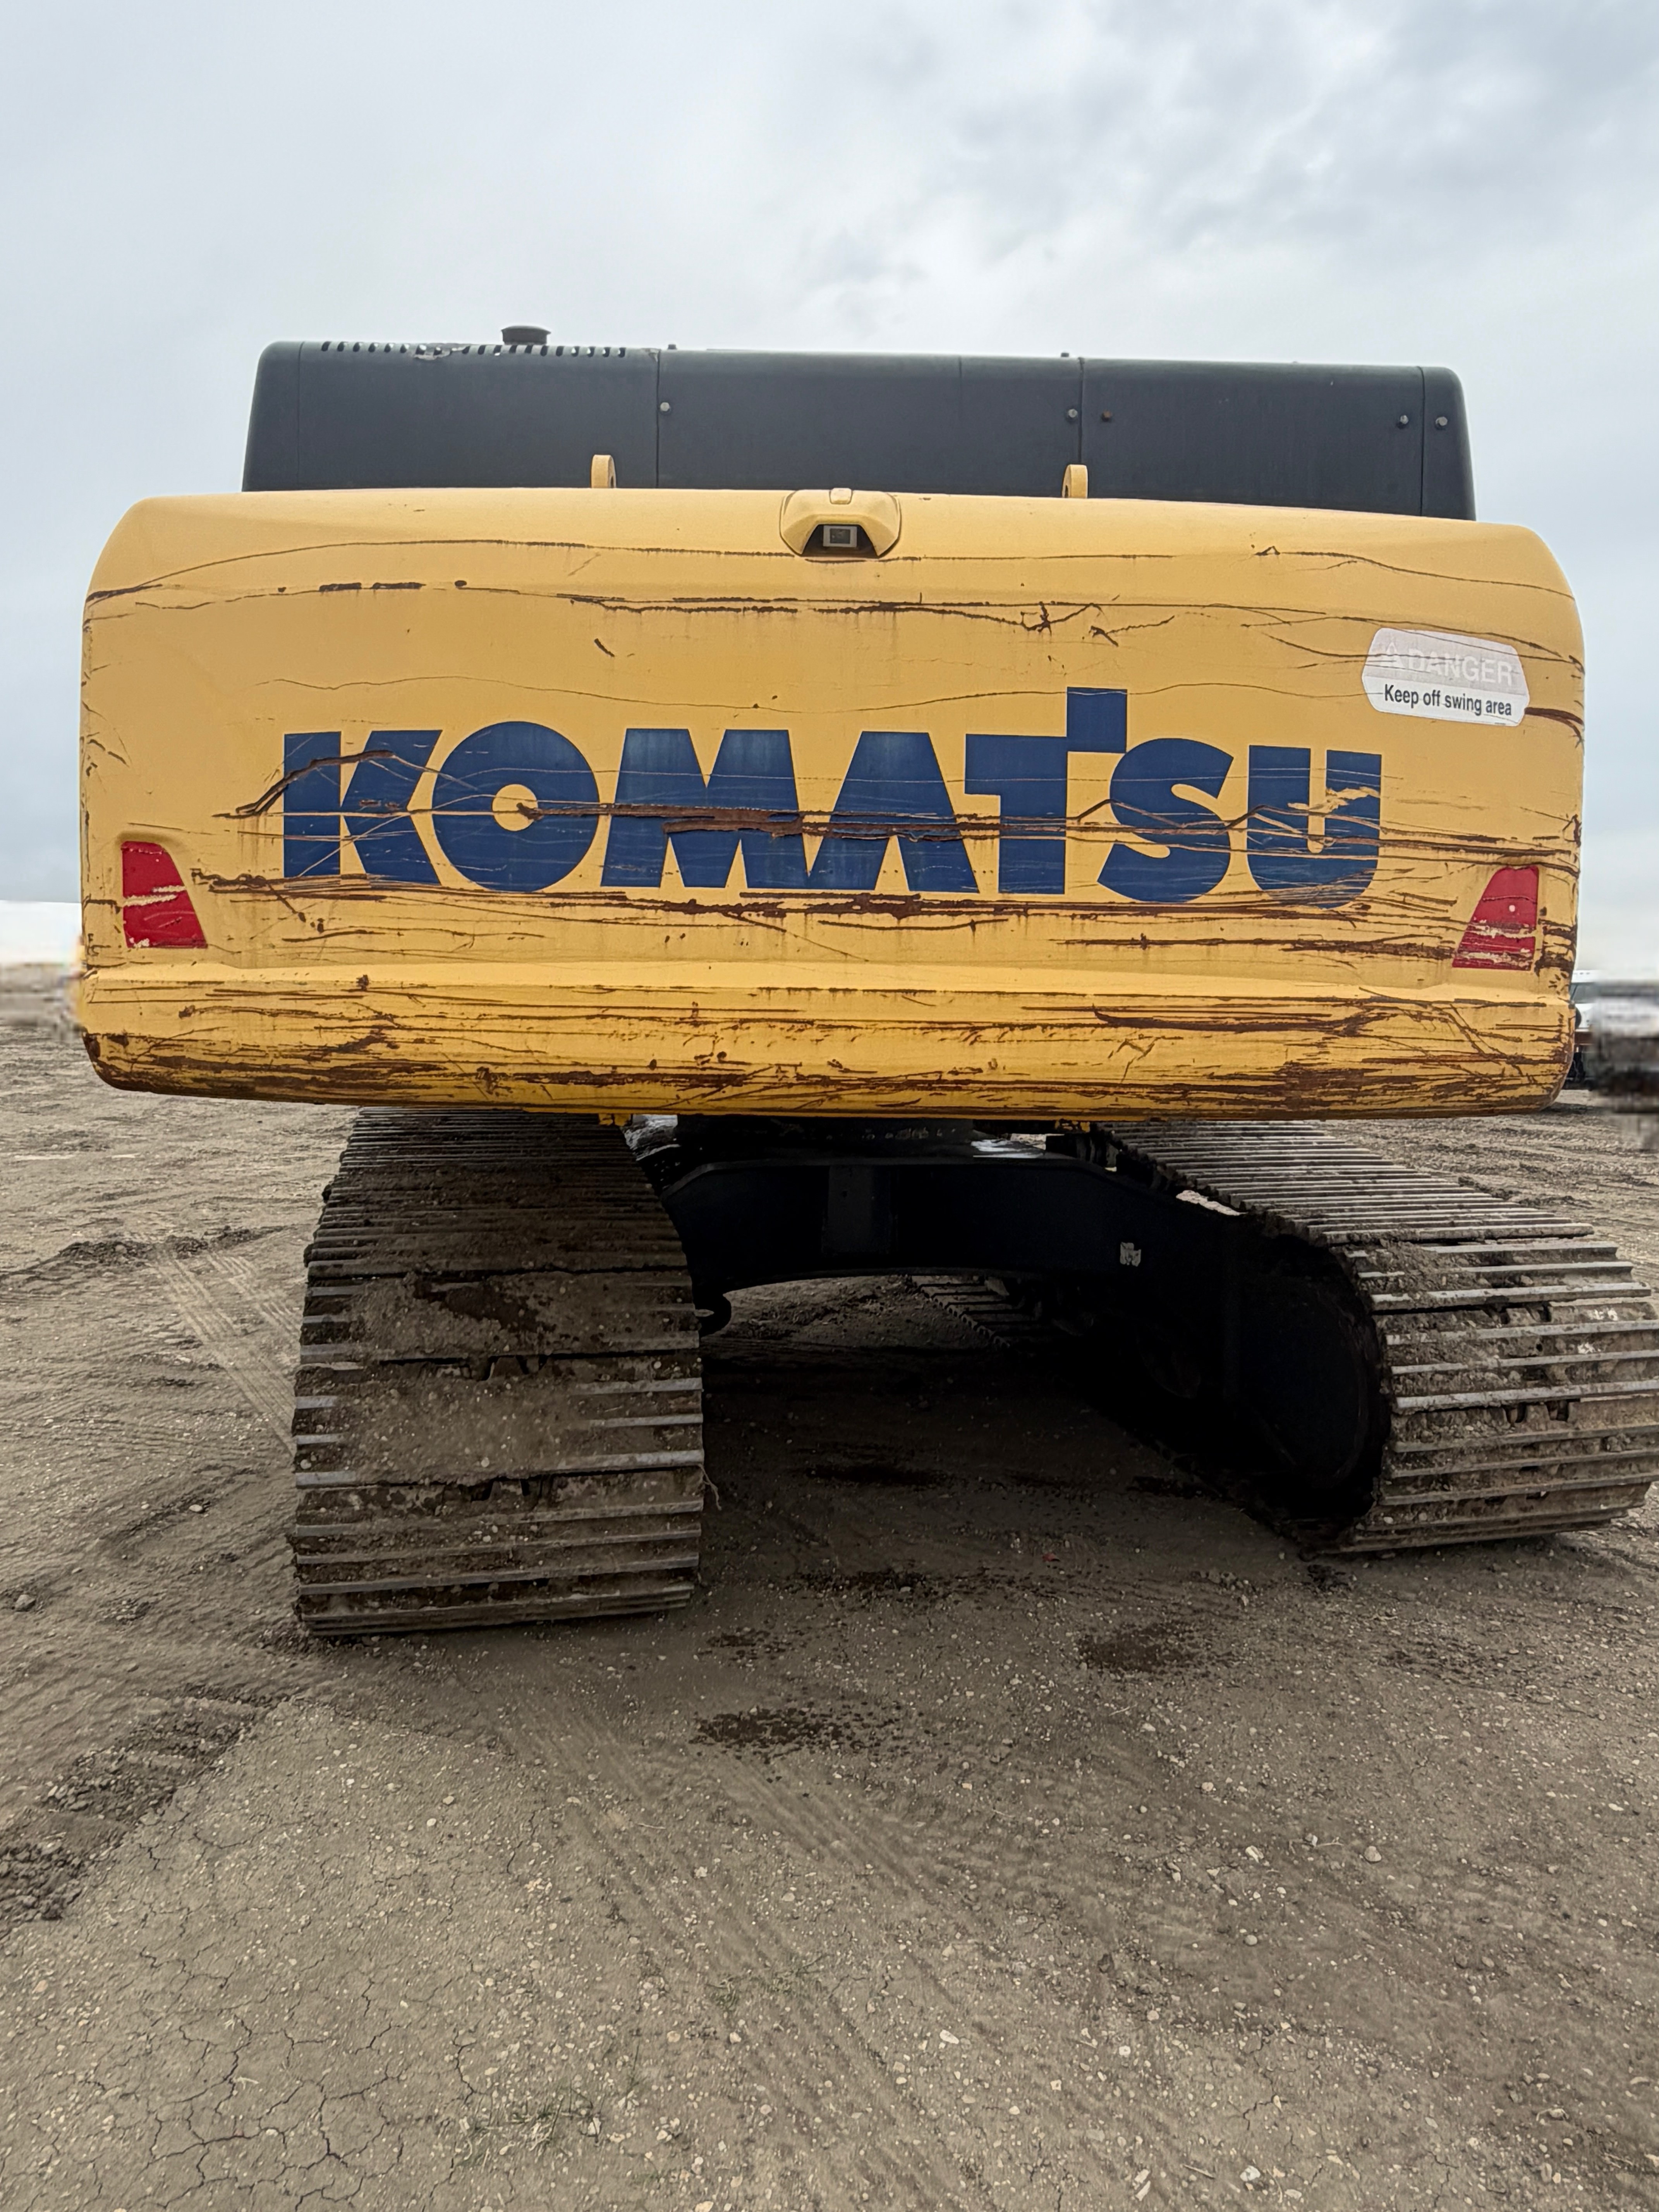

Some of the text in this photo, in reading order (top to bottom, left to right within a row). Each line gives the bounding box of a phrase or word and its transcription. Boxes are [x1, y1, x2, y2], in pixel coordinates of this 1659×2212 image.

[1408, 648, 1511, 685] DANGER
[1384, 684, 1512, 716] Keep off swing area
[284, 687, 1381, 908] KOMATSU
